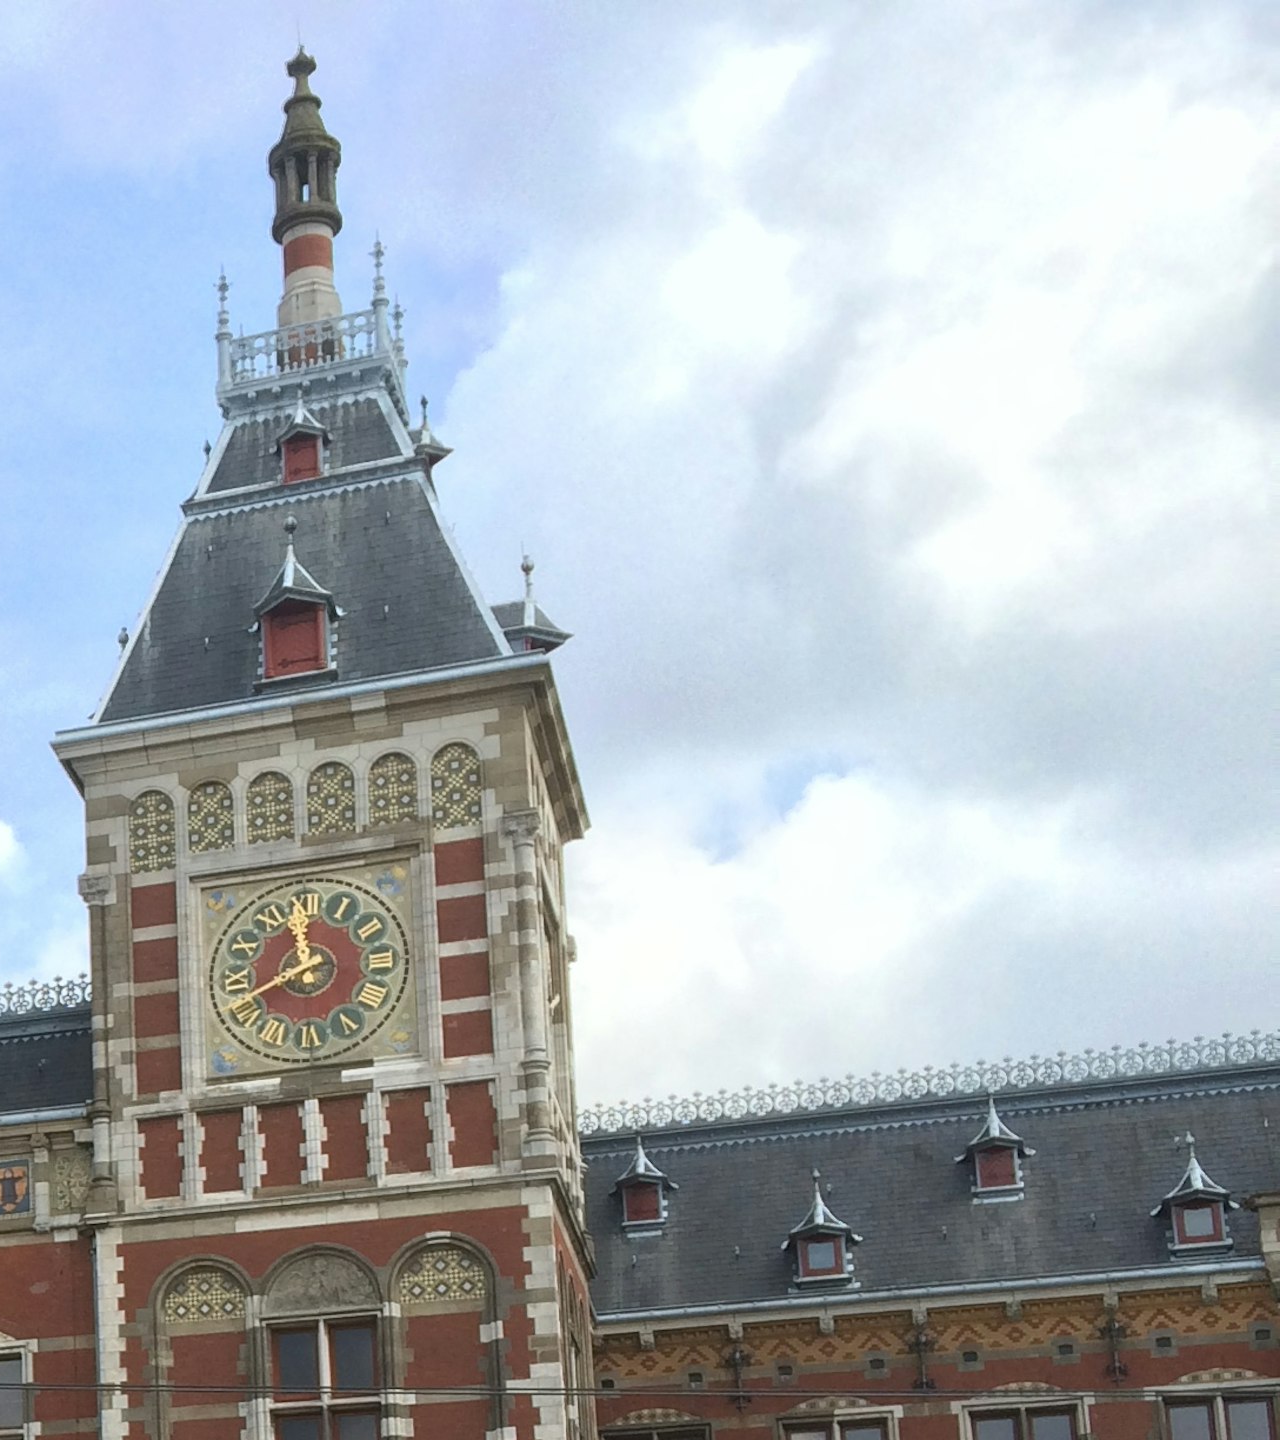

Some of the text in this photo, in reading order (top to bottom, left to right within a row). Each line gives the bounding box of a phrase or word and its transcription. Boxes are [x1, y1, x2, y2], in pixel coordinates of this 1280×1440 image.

[254, 905, 286, 931] XI
[357, 918, 383, 941] II
[231, 935, 259, 956] X
[368, 950, 393, 970] III
